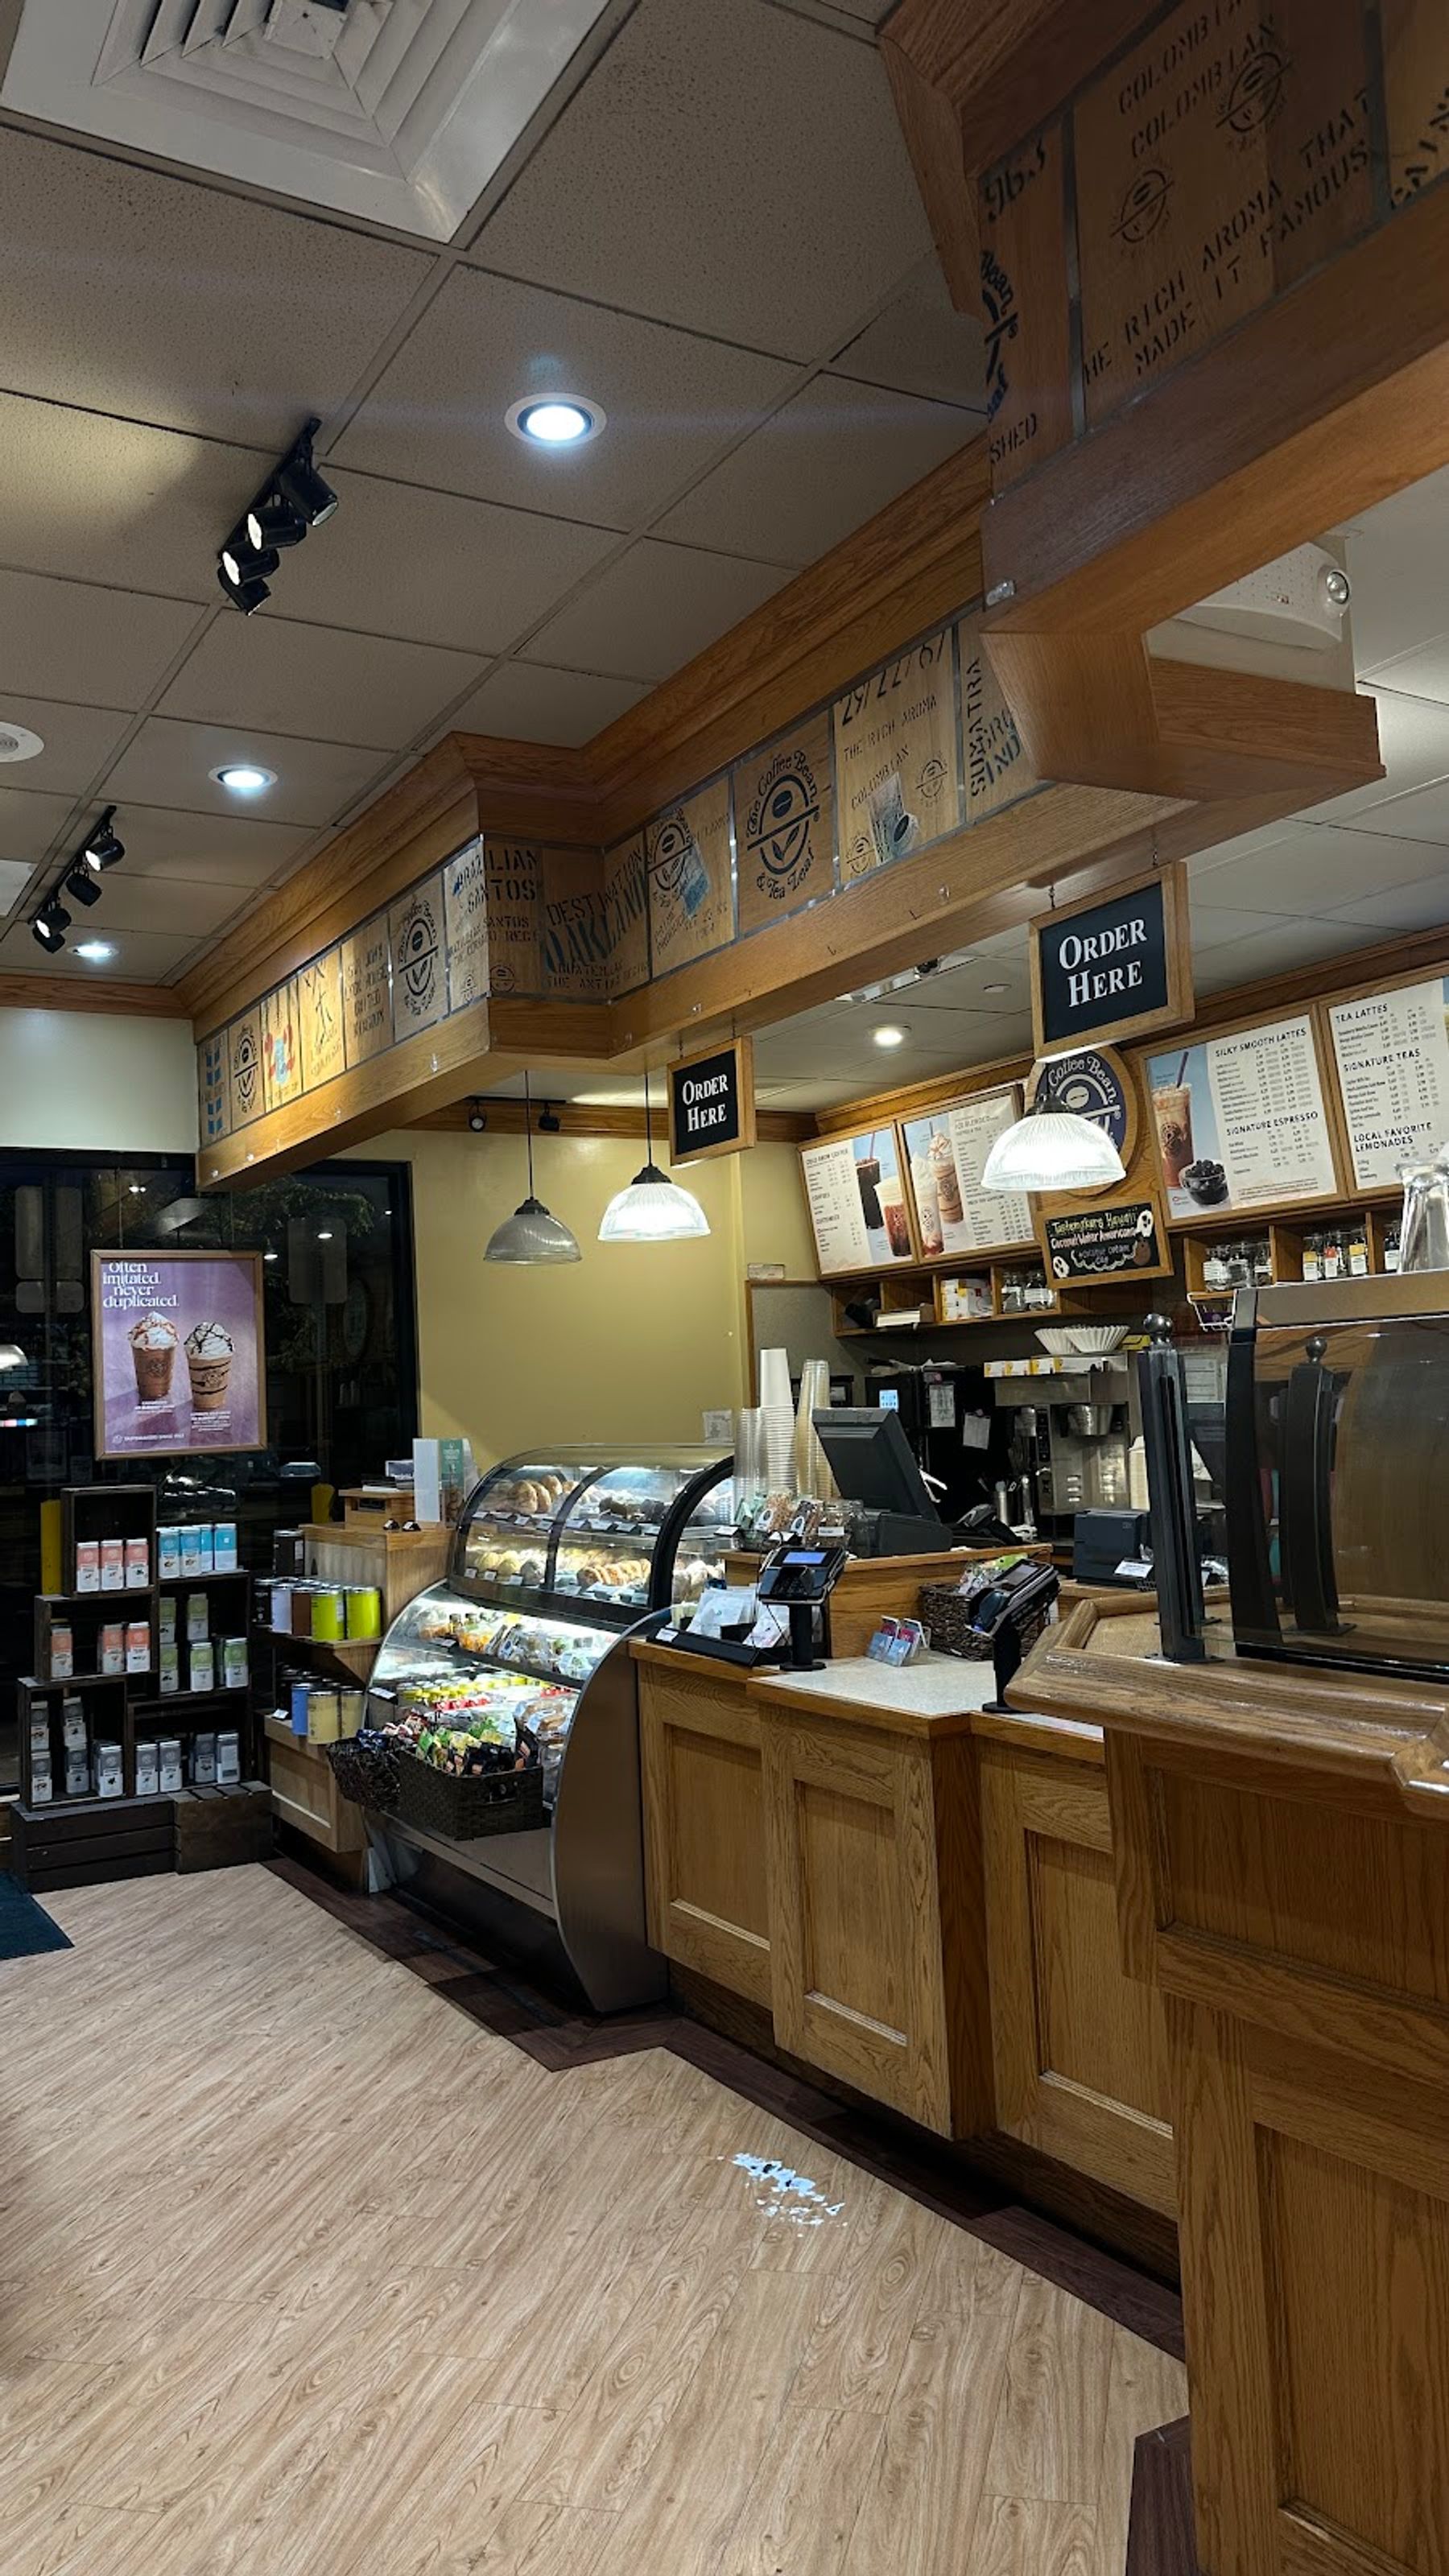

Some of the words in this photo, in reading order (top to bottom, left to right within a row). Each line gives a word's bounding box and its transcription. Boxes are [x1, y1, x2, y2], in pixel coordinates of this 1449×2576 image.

[1083, 341, 1112, 385] HE
[1125, 270, 1185, 345] RICH
[1203, 179, 1282, 272] AROMA
[1300, 88, 1369, 168] THAT
[1135, 301, 1195, 374] MADE
[1215, 256, 1240, 298] IT
[1261, 139, 1369, 256] FAMOUS
[843, 739, 863, 762] THE
[868, 720, 895, 745] RICH
[758, 753, 792, 797] Coffee
[547, 847, 642, 925] DESTINATION
[766, 877, 786, 899] Tea
[1059, 919, 1147, 969] ORDER
[1067, 960, 1142, 1007] HERE
[1335, 1013, 1353, 1023] TEA
[1356, 1003, 1388, 1018] LATTES
[1215, 1046, 1238, 1057] SILKY
[1240, 1036, 1275, 1051] SMOOTH
[1276, 1027, 1307, 1042] LATTES
[1048, 1058, 1085, 1086] Coffee
[1343, 1055, 1394, 1072] SIGNATURE
[1396, 1048, 1421, 1060] TEAS
[683, 1074, 729, 1105] ORDER
[687, 1103, 727, 1133] HERE
[1226, 1120, 1272, 1136] SIGNATURE
[1274, 1110, 1319, 1127] ESPRESSO
[1353, 1130, 1382, 1143] LOCAL
[1384, 1121, 1432, 1137] FAVORITE
[1355, 1135, 1414, 1153] LEMONADES
[109, 1261, 147, 1273] Often
[103, 1294, 180, 1311] duplicated.
[114, 1284, 155, 1296] never
